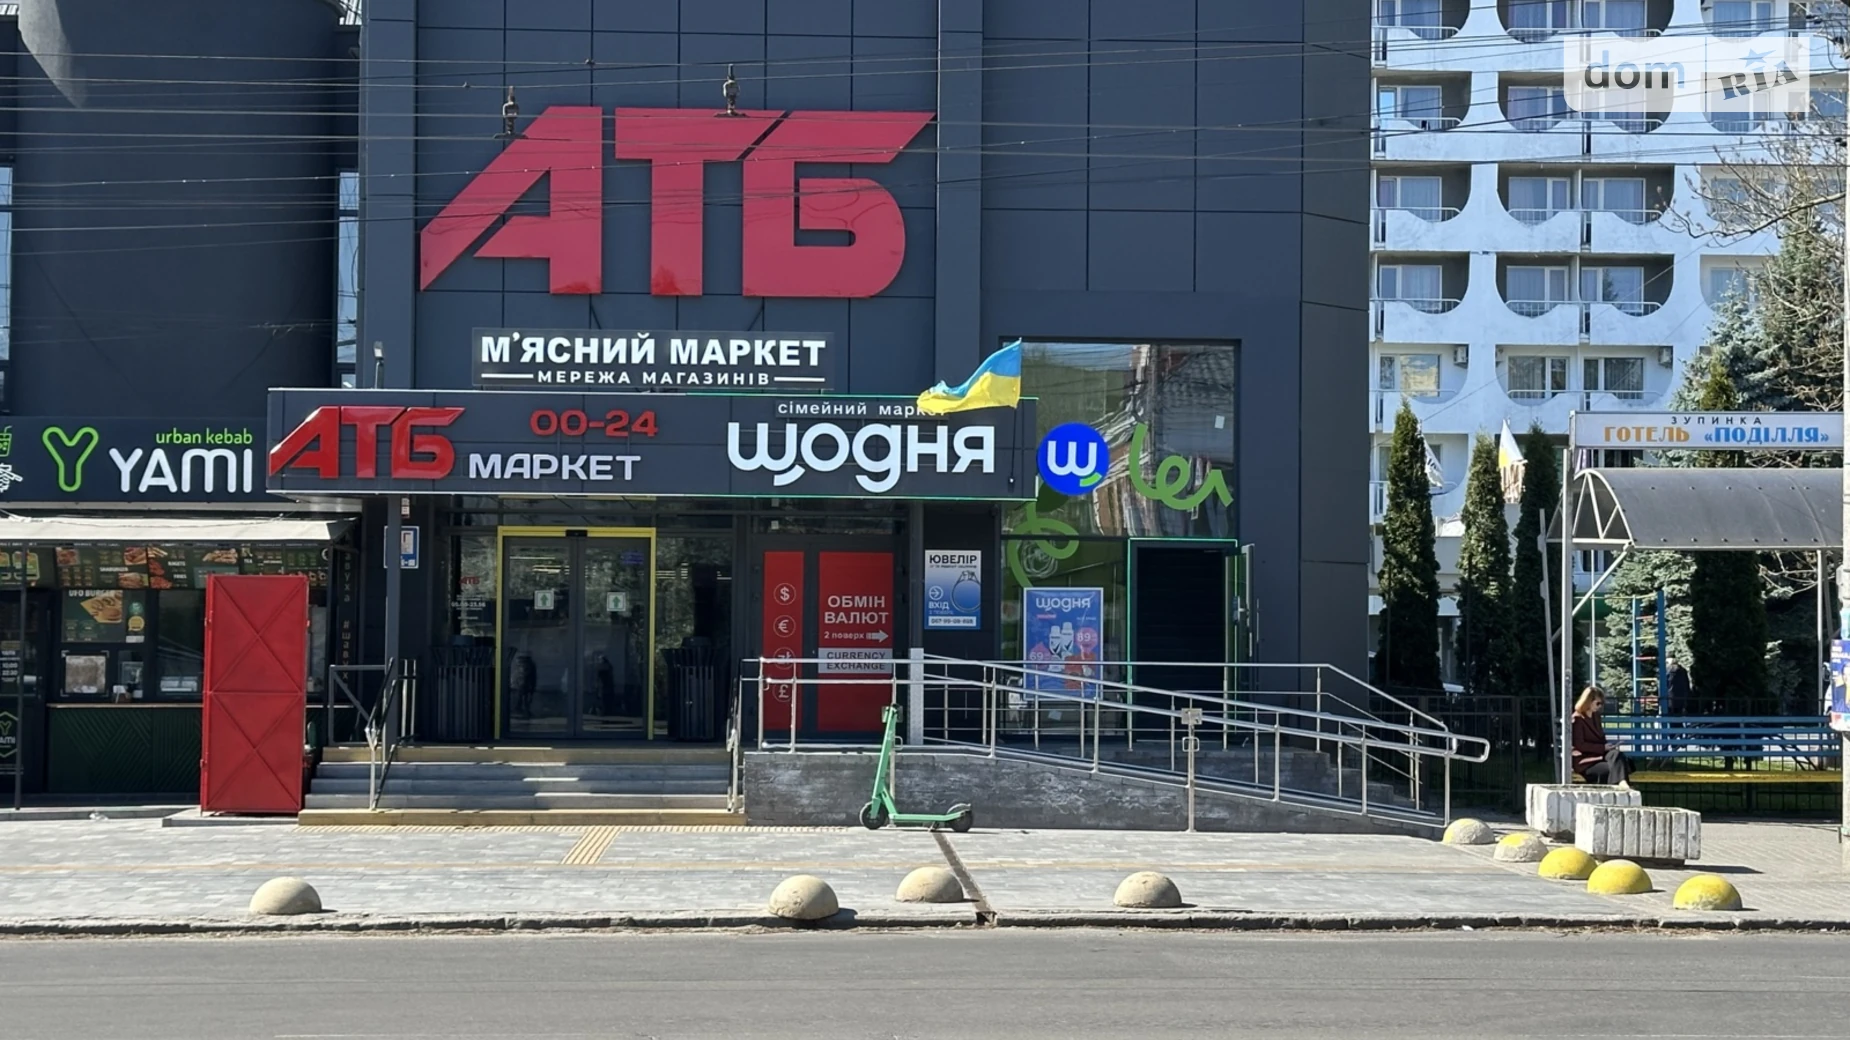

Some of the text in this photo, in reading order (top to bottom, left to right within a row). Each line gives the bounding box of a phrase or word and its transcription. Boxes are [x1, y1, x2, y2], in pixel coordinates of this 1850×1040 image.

[420, 106, 937, 298] АТБ
[481, 332, 826, 367] М’ЯСНИЙ МАРКЕТ
[537, 370, 770, 386] МЕРЕЖА МАГАЗИНІВ
[778, 402, 945, 418] сімейний марк
[530, 410, 658, 437] 00-24
[1671, 416, 1762, 425] ЗУПИНКА
[156, 428, 252, 444] urban kebab
[269, 406, 465, 479] АТБ
[1604, 426, 1829, 445] ГОТЕЛЬ «ПОДІЛЛЯ»
[108, 448, 252, 493] YAMI
[469, 453, 641, 481] МАРКЕТ
[929, 555, 977, 564] ЮВЕЛІР
[827, 595, 885, 608] ОБМІН
[928, 601, 950, 610] ВХІД
[824, 611, 889, 625] ВАЛЮТ
[824, 631, 864, 641] 2 поверх
[827, 651, 886, 660] CURRENCY
[826, 661, 886, 670] EXCHANGE
